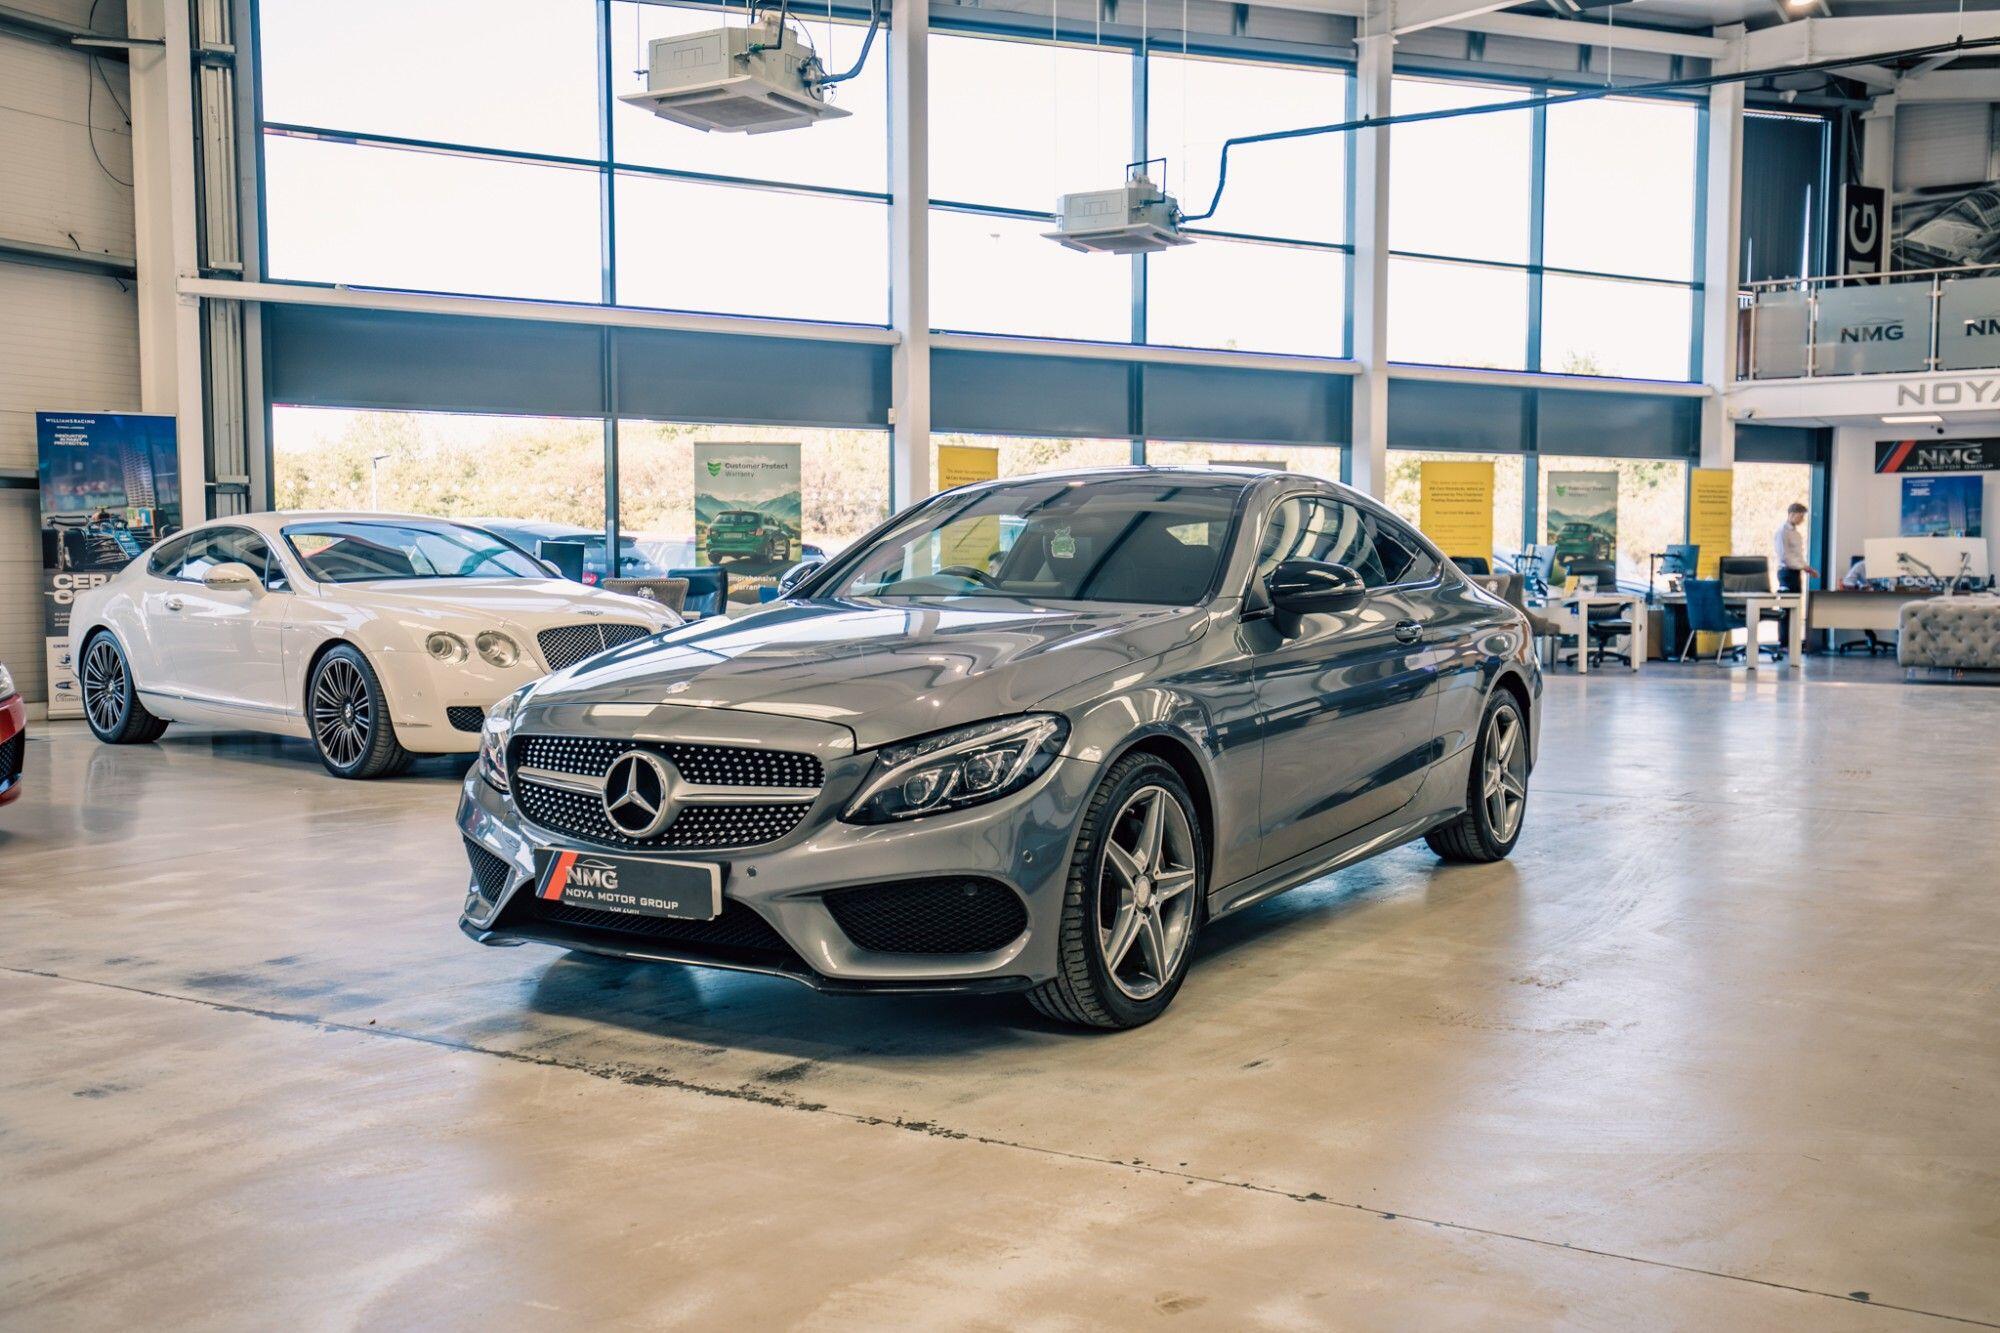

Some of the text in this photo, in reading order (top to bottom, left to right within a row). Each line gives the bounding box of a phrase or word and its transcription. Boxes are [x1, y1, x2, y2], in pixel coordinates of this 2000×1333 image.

[1840, 325, 1904, 343] NMG
[724, 462, 760, 470] Customer
[1918, 449, 1983, 465] NMG
[565, 866, 618, 890] NMG
[566, 888, 679, 910] NOYA MOTOR GROUP
